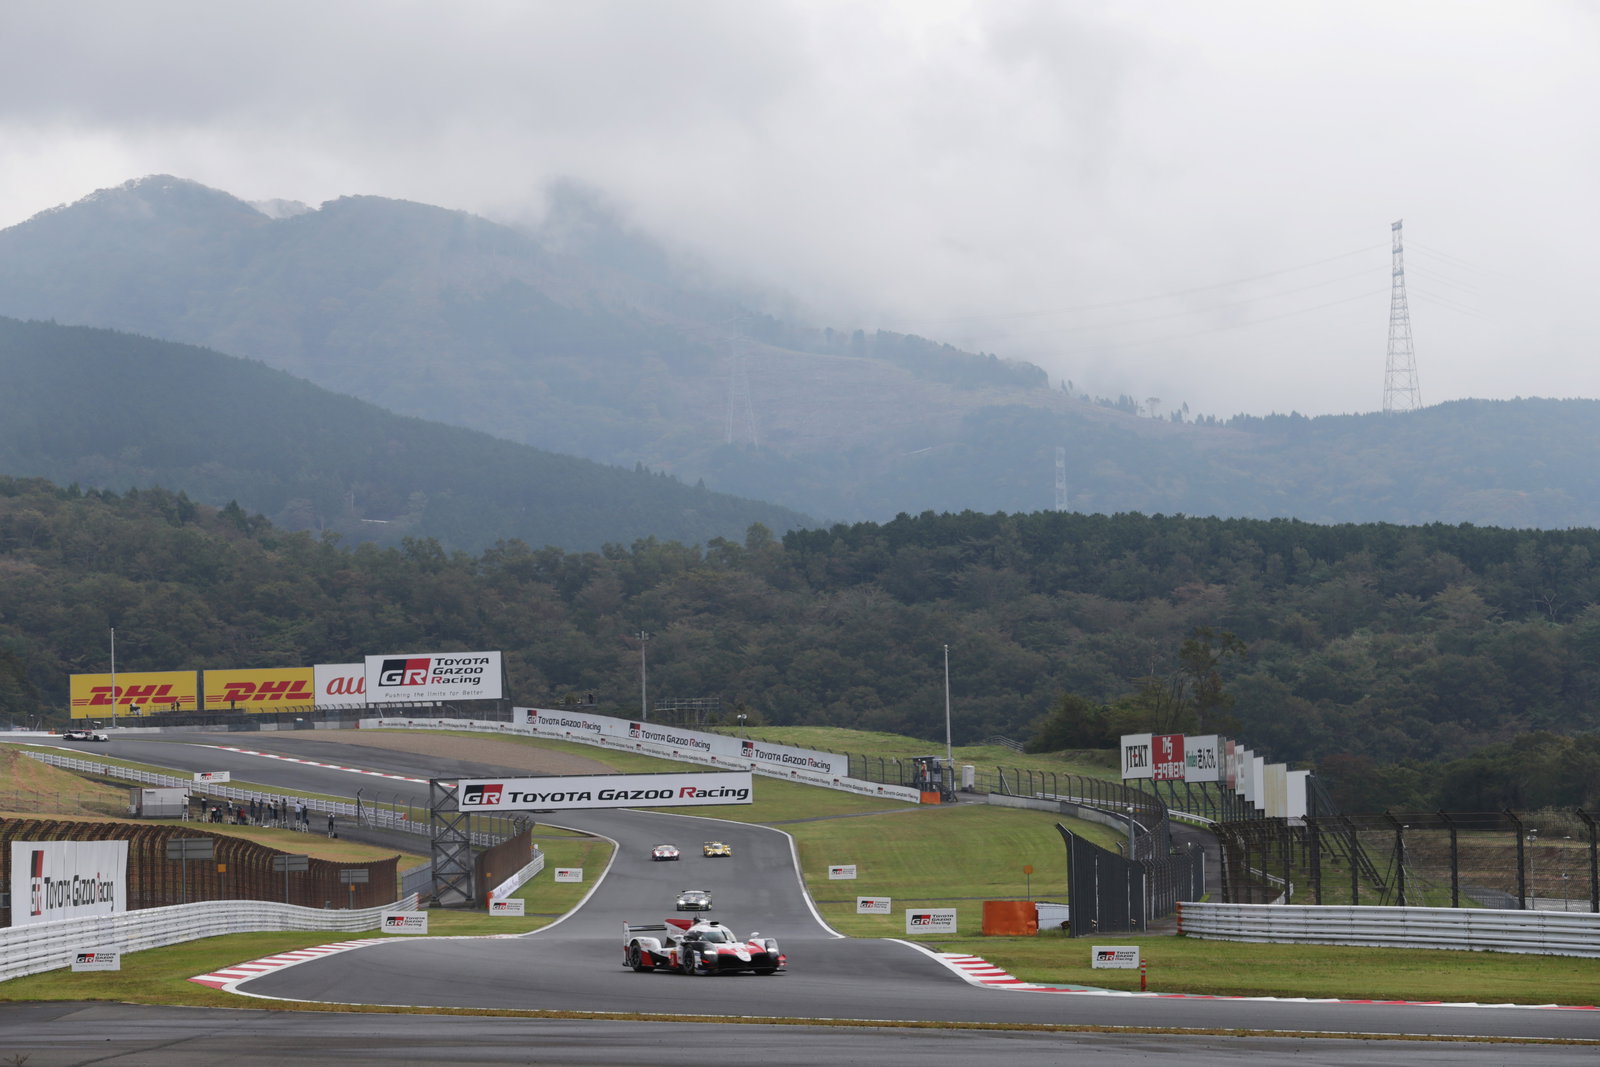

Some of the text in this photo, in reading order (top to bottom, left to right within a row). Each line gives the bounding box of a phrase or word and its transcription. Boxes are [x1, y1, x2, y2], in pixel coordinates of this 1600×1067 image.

[432, 667, 483, 675] GAZOO
[435, 657, 489, 666] TOYOTA
[326, 676, 365, 696] au
[431, 675, 481, 686] Racing
[88, 684, 179, 706] DHL
[222, 680, 313, 702] DHL
[538, 716, 560, 726] TOYOTA
[560, 718, 581, 728] GAZOO
[581, 720, 602, 733] Racing
[641, 730, 665, 741] TOYOTA
[666, 734, 688, 746] GAZOO
[689, 738, 711, 751] Racing
[755, 749, 781, 761] TOYOTA
[782, 754, 807, 766] GAZOO
[807, 757, 831, 772] Racing
[1125, 745, 1148, 773] JTEKT
[508, 791, 591, 803] TOYOTA
[597, 788, 674, 801] GAZOO
[678, 786, 749, 801] Racing
[44, 876, 71, 910] TOYOTA
[72, 875, 95, 907] GAZOO
[96, 872, 114, 912] Racing
